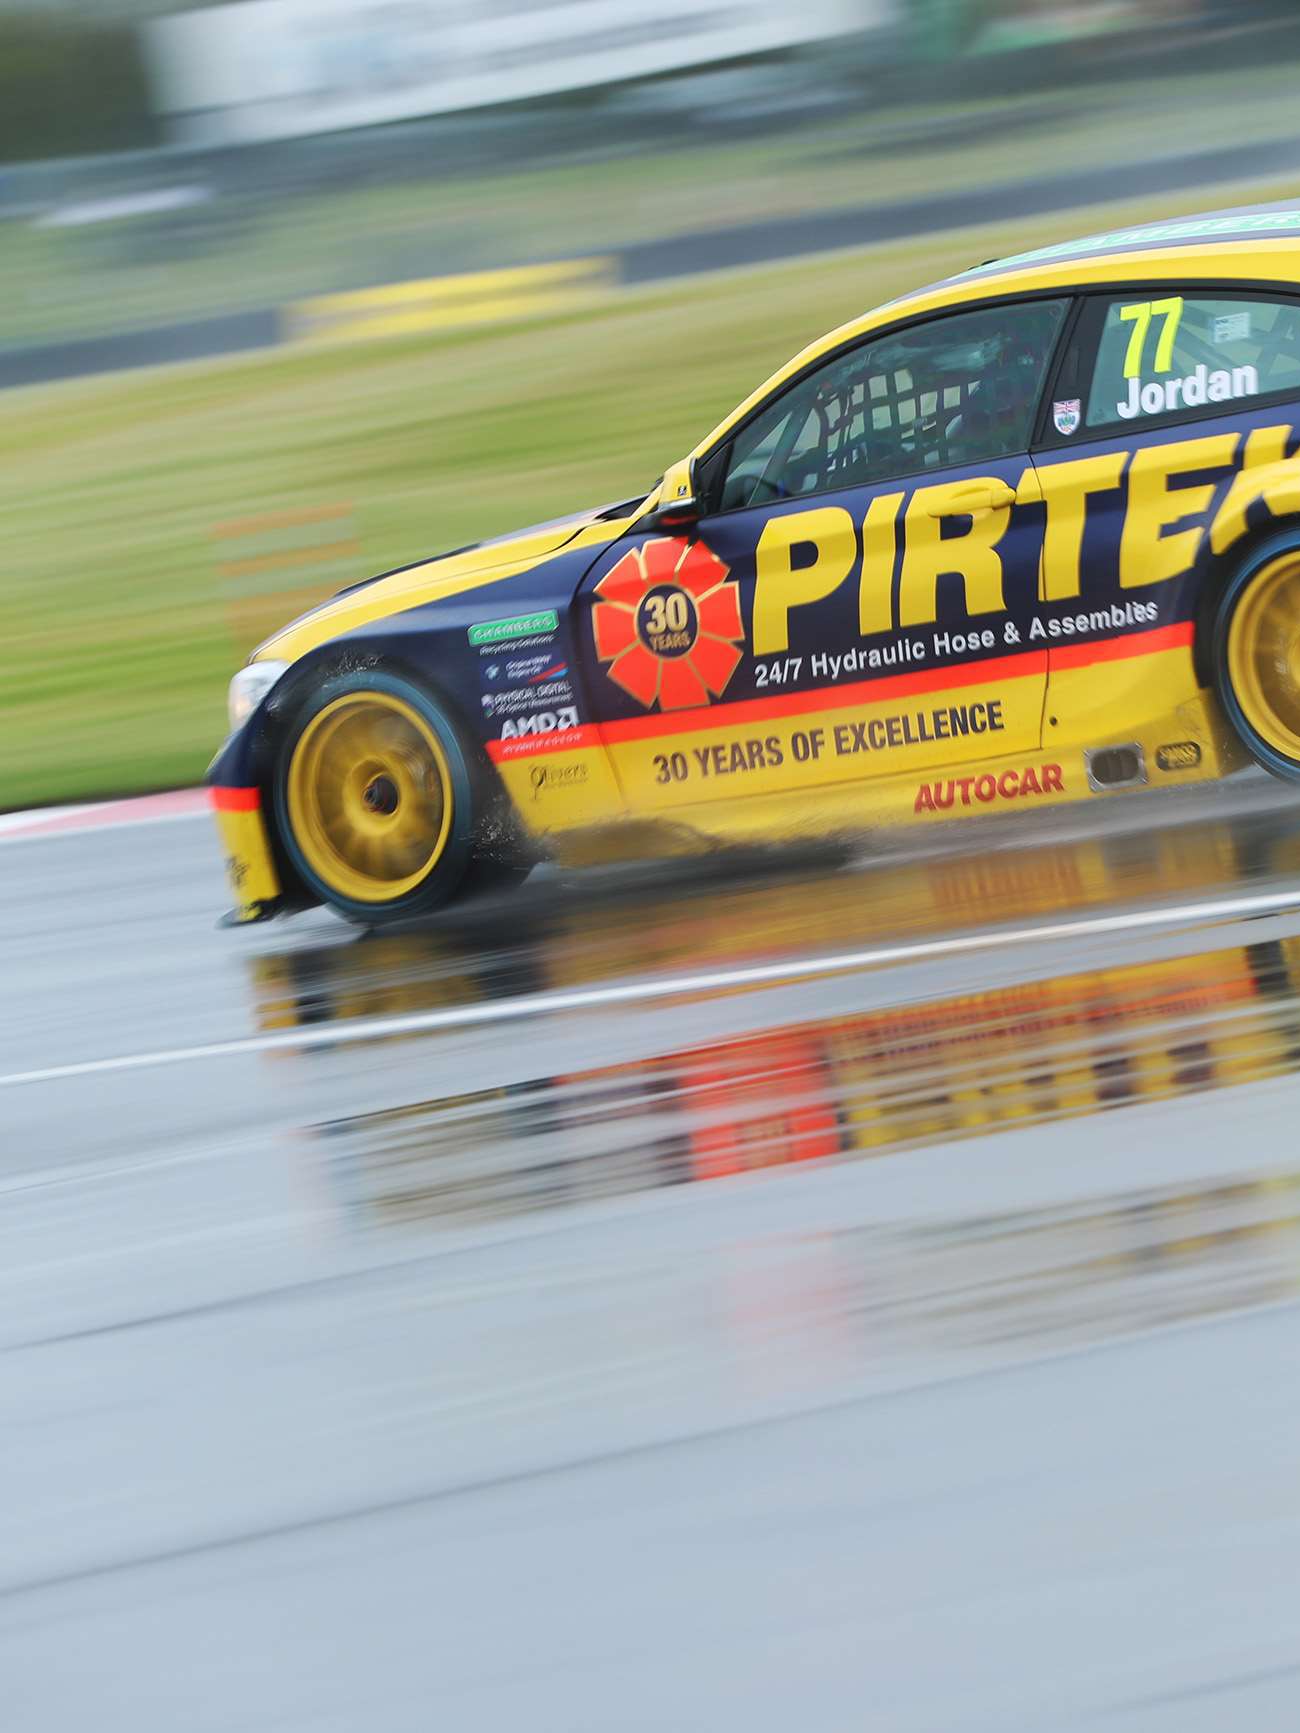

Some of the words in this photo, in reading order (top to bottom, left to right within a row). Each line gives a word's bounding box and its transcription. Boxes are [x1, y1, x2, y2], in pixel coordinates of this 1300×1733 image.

[1119, 296, 1184, 379] 77
[1116, 363, 1259, 420] Jordan
[644, 591, 689, 635] 30
[649, 631, 691, 650] YEARS
[754, 656, 803, 688] 24/7
[811, 638, 926, 680] Hydraulic
[933, 628, 996, 657] Hose
[1003, 621, 1022, 645] &
[1029, 600, 1159, 641] Assemblies
[653, 751, 689, 785] 30
[693, 735, 784, 777] YEARS
[791, 727, 826, 763] OF
[833, 700, 1005, 757] EXCELLENCE
[913, 762, 1066, 815] AUTOCAR
